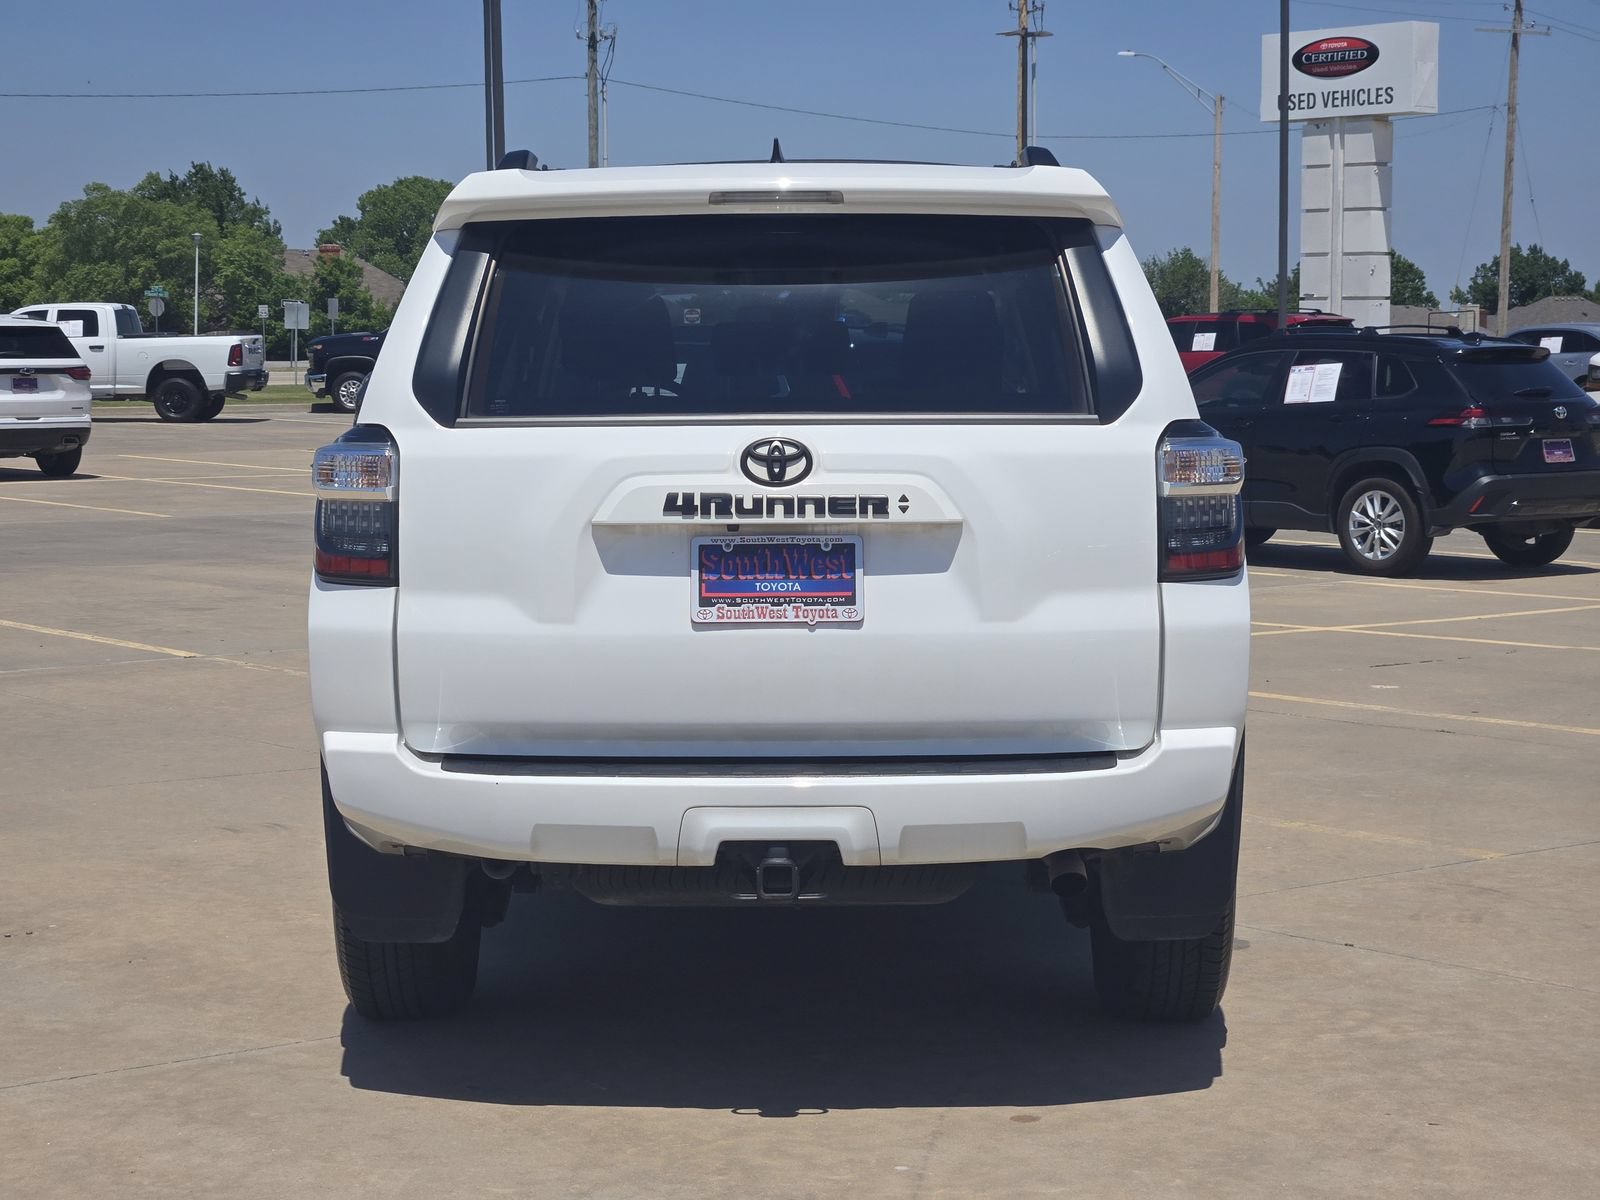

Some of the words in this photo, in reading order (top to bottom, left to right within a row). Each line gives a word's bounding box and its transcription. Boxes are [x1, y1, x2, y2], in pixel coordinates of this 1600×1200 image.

[1302, 50, 1367, 64] CERTIFIED
[1278, 92, 1317, 111] SED
[1321, 86, 1394, 109] VEHICLES
[710, 536, 843, 544] www.SouthWestToyota.com
[755, 582, 801, 592] TOYOTA
[716, 606, 788, 620] SouthWest
[792, 606, 838, 622] Toyota
